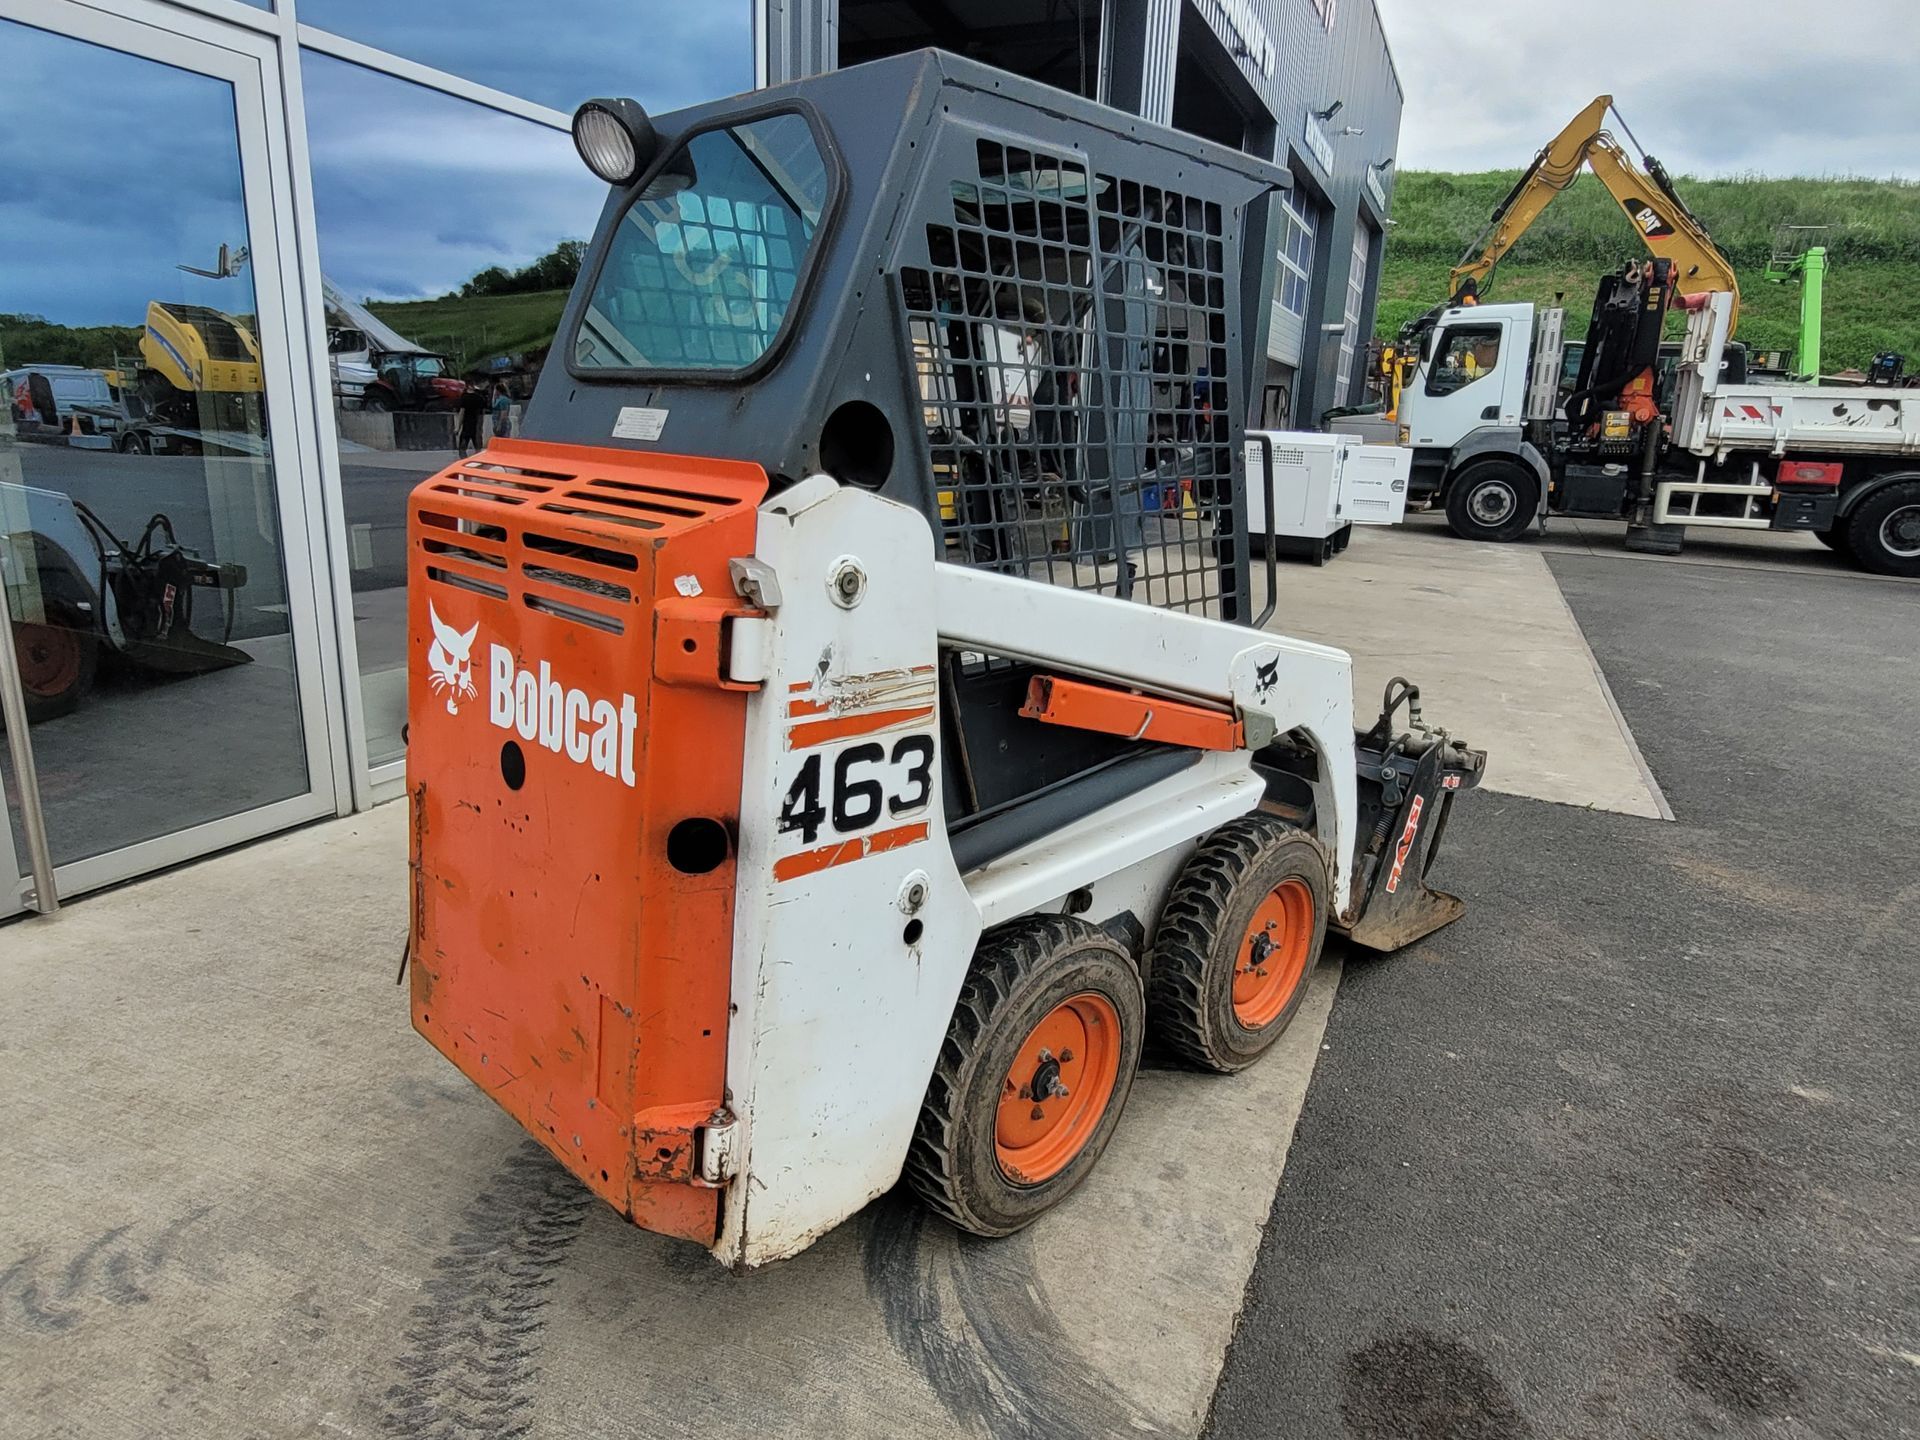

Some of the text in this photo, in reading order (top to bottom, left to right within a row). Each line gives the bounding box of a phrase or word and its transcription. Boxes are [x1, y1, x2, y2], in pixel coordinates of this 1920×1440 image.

[1636, 207, 1662, 233] CAT
[490, 643, 638, 788] Bobcat
[777, 734, 934, 844] 463
